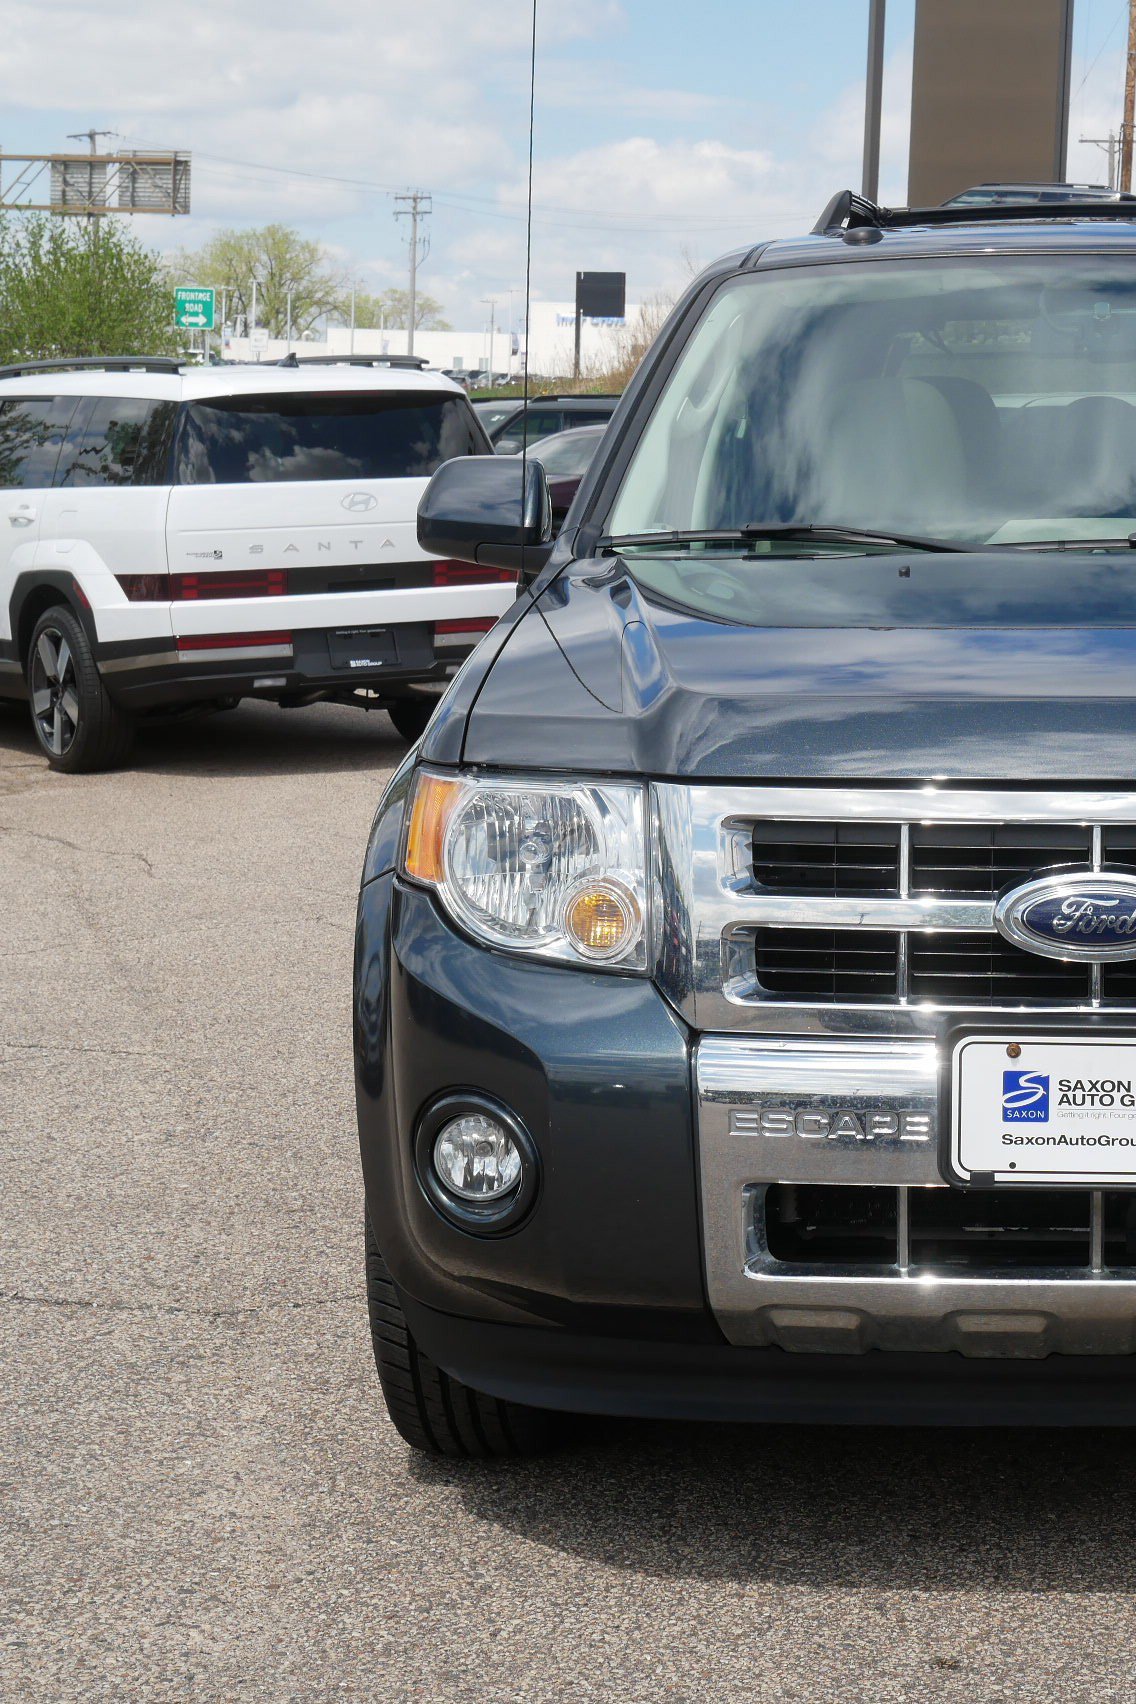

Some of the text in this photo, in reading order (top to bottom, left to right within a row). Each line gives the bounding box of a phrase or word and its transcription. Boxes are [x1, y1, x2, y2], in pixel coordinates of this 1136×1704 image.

[177, 291, 211, 302] FRONTAGE
[184, 303, 203, 313] ROAD
[249, 538, 396, 554] SANTA
[1058, 1079, 1132, 1093] SAXON
[1057, 1093, 1115, 1107] AUTO
[1006, 1109, 1045, 1119] SAXON
[1056, 1110, 1085, 1120] Getting
[1109, 1111, 1126, 1119] Four
[728, 1108, 930, 1140] ESCAPE
